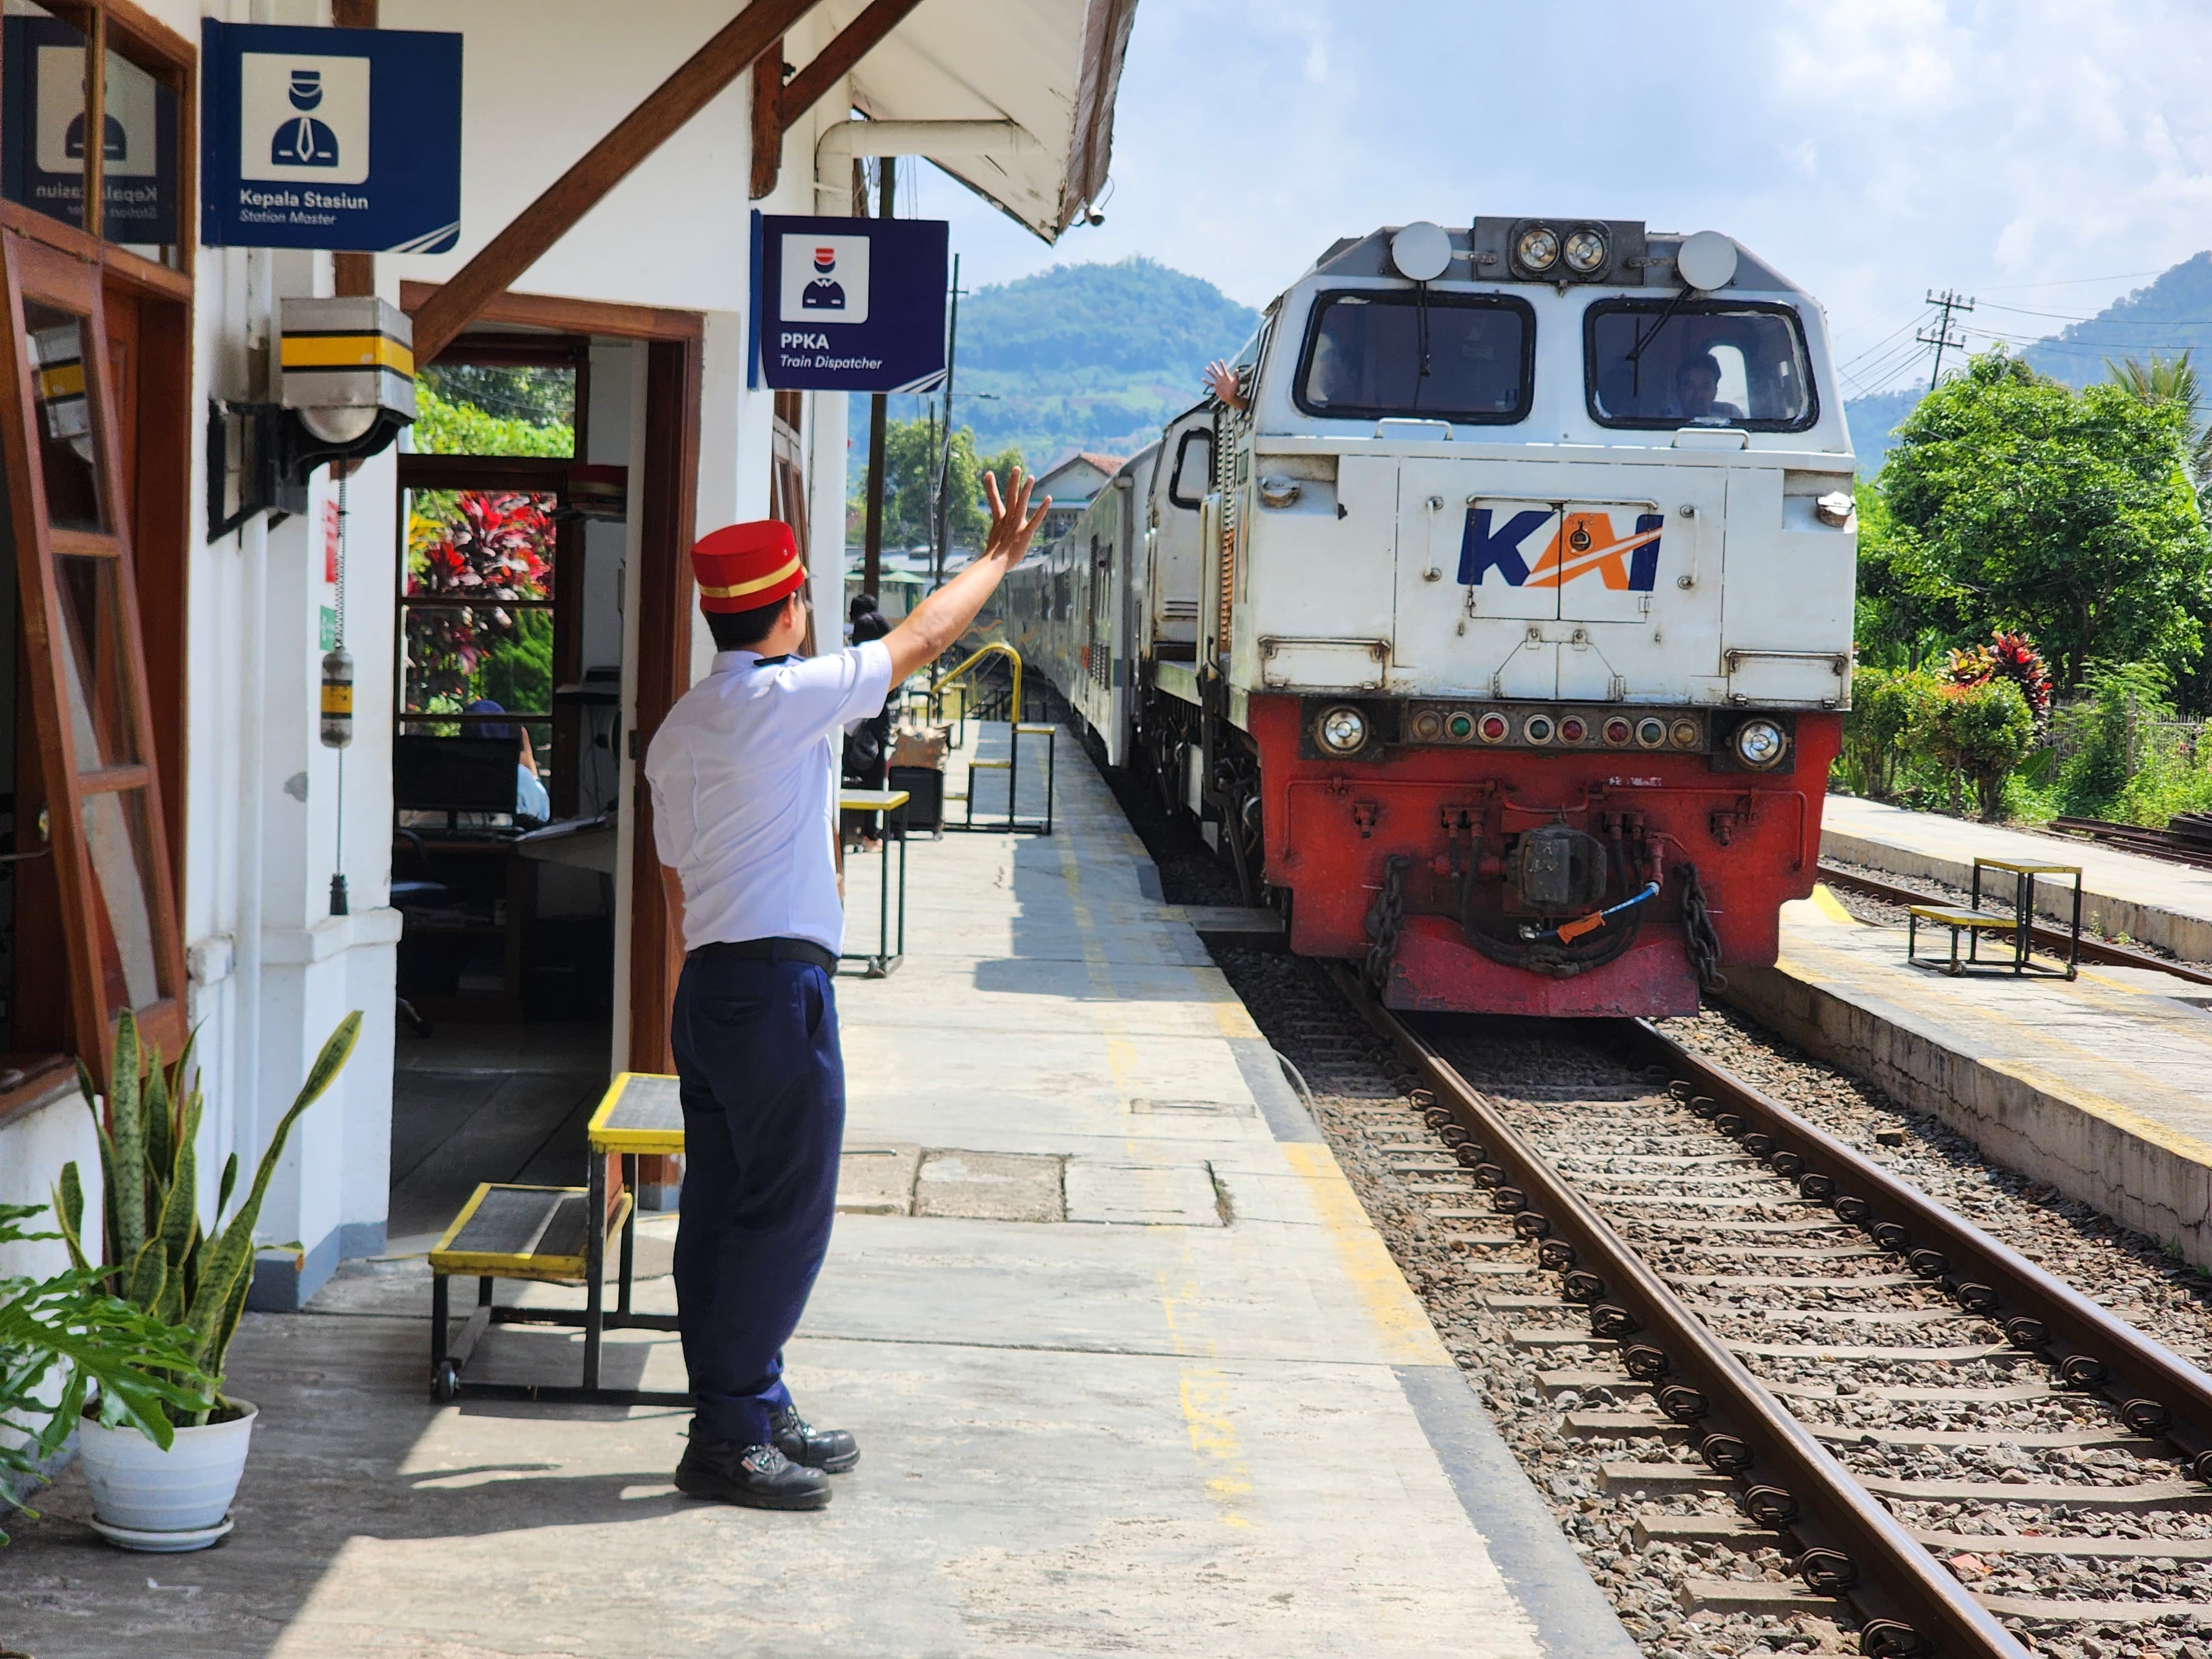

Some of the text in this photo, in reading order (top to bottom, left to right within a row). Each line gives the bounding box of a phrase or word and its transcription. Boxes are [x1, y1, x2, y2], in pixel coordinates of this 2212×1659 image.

[240, 189, 368, 210] Kepala Stasiun
[240, 208, 336, 225] Station Master
[780, 333, 830, 349] PPKA
[780, 354, 883, 371] Train Dispatcher
[1457, 508, 1665, 591] KAI
